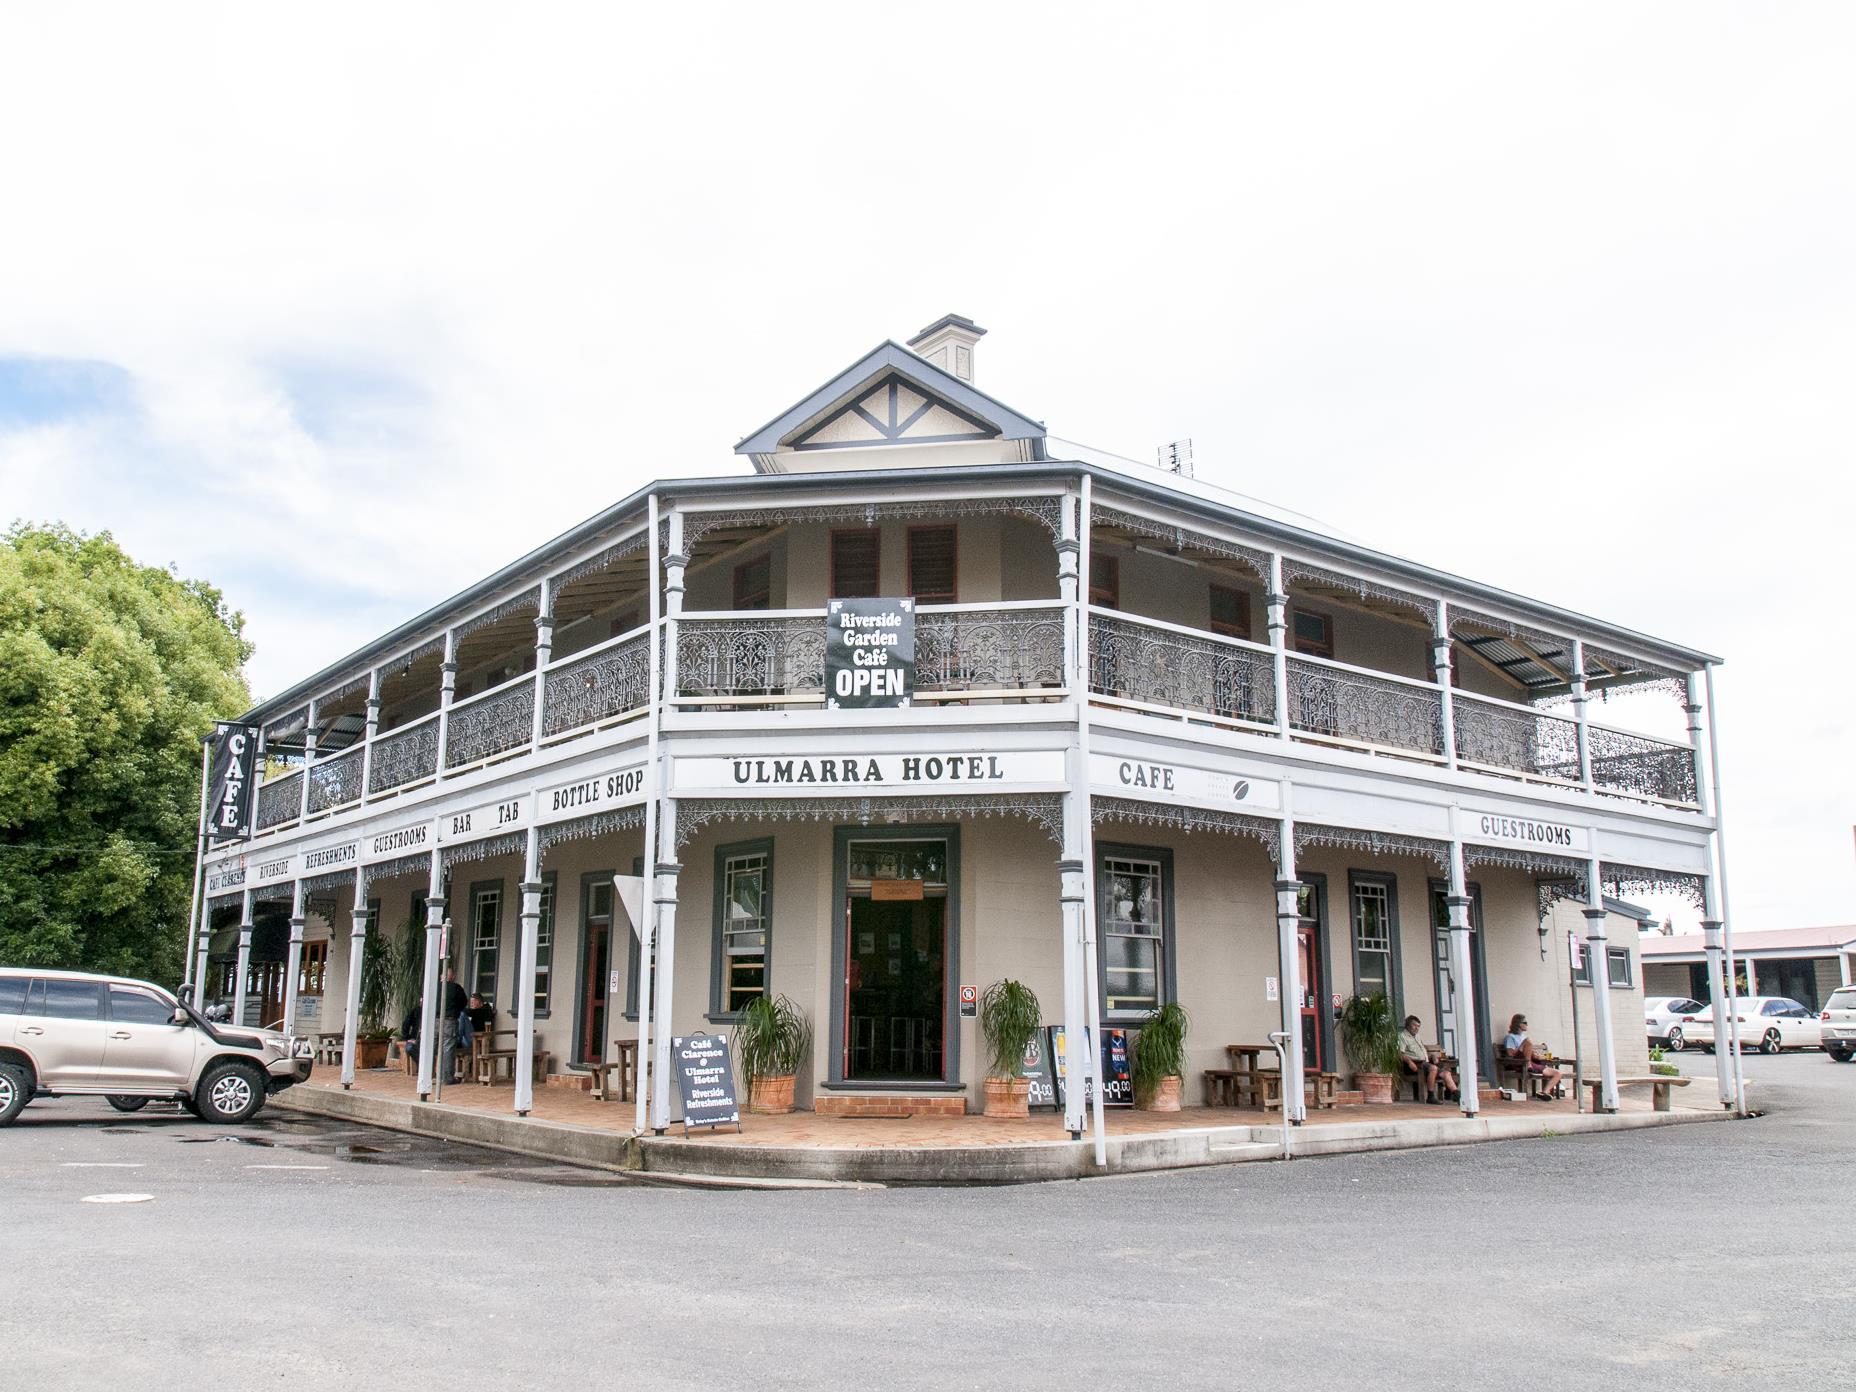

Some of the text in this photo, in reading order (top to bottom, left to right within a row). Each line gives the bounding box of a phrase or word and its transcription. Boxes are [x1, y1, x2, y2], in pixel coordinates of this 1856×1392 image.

[840, 613, 902, 628] Riverside
[843, 630, 898, 647] Garden
[853, 648, 888, 666] Café
[835, 668, 905, 697] OPEN
[733, 756, 1004, 784] ULMARRA HOTEL
[1119, 761, 1175, 791] CAFE
[552, 769, 644, 811] BOTTLE SHOP
[453, 801, 519, 835] BAR TAB
[373, 825, 427, 854] GUESTROOMS
[1481, 816, 1571, 846] GUESTROOMS
[305, 843, 356, 869] REFRESHMENTS
[259, 860, 289, 879] RIVERSIDE
[682, 1050, 723, 1058] Clarence
[1112, 1054, 1126, 1062] NEW
[685, 1067, 725, 1076] Ulmarra
[694, 1075, 719, 1084] Hotel
[692, 1088, 724, 1098] Riverside
[687, 1097, 733, 1108] Refreshments
